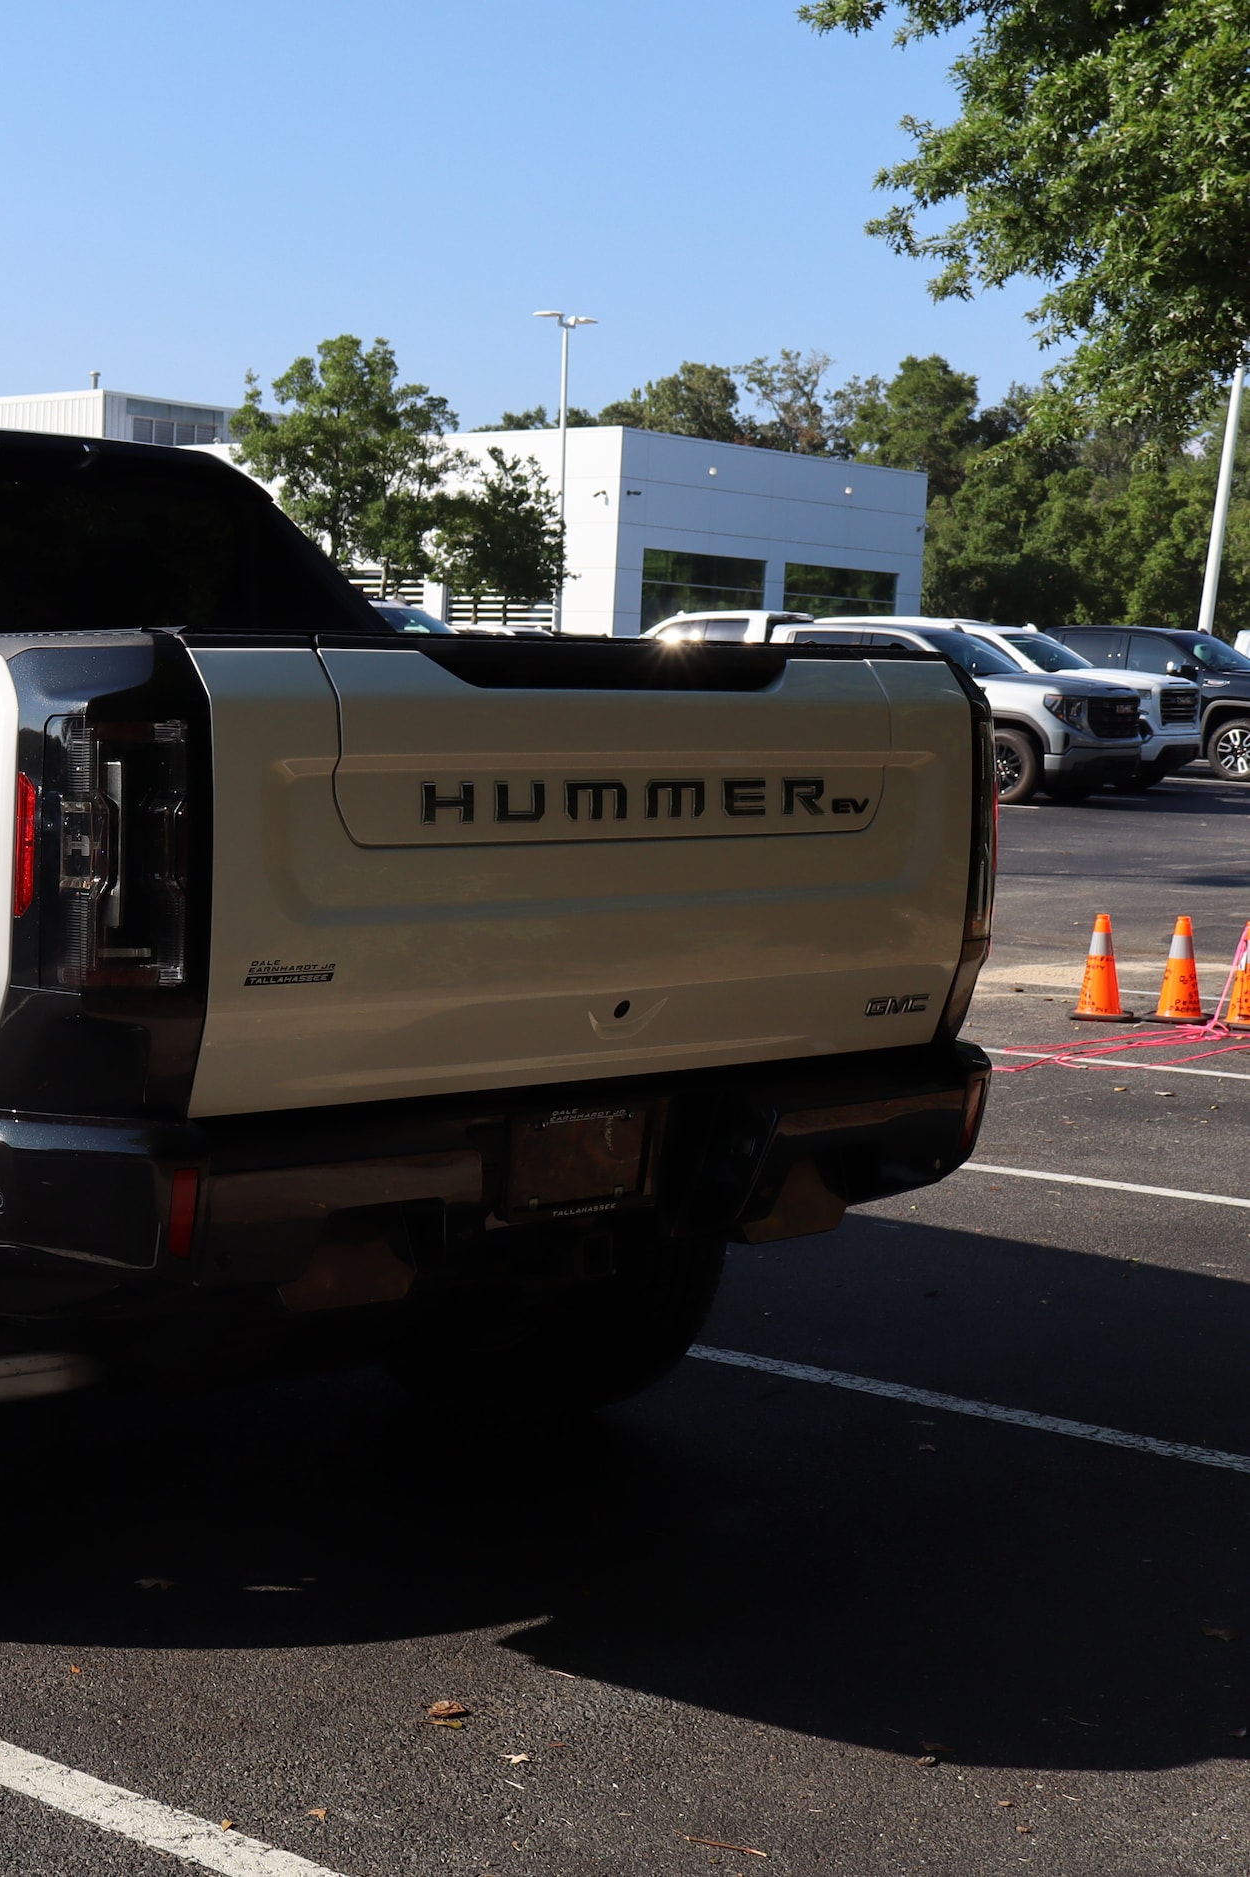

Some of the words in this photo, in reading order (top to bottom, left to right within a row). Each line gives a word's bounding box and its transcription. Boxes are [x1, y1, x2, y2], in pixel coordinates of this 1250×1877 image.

[421, 777, 825, 824] HUMMER
[832, 798, 870, 814] EV
[249, 964, 318, 973] EARNHARDT
[250, 974, 329, 985] TALLAHASSEE
[864, 994, 930, 1016] GMC
[550, 1110, 610, 1122] EARNHARDT
[552, 1108, 579, 1117] DALE
[552, 1203, 617, 1217] TALLAHASSEE
